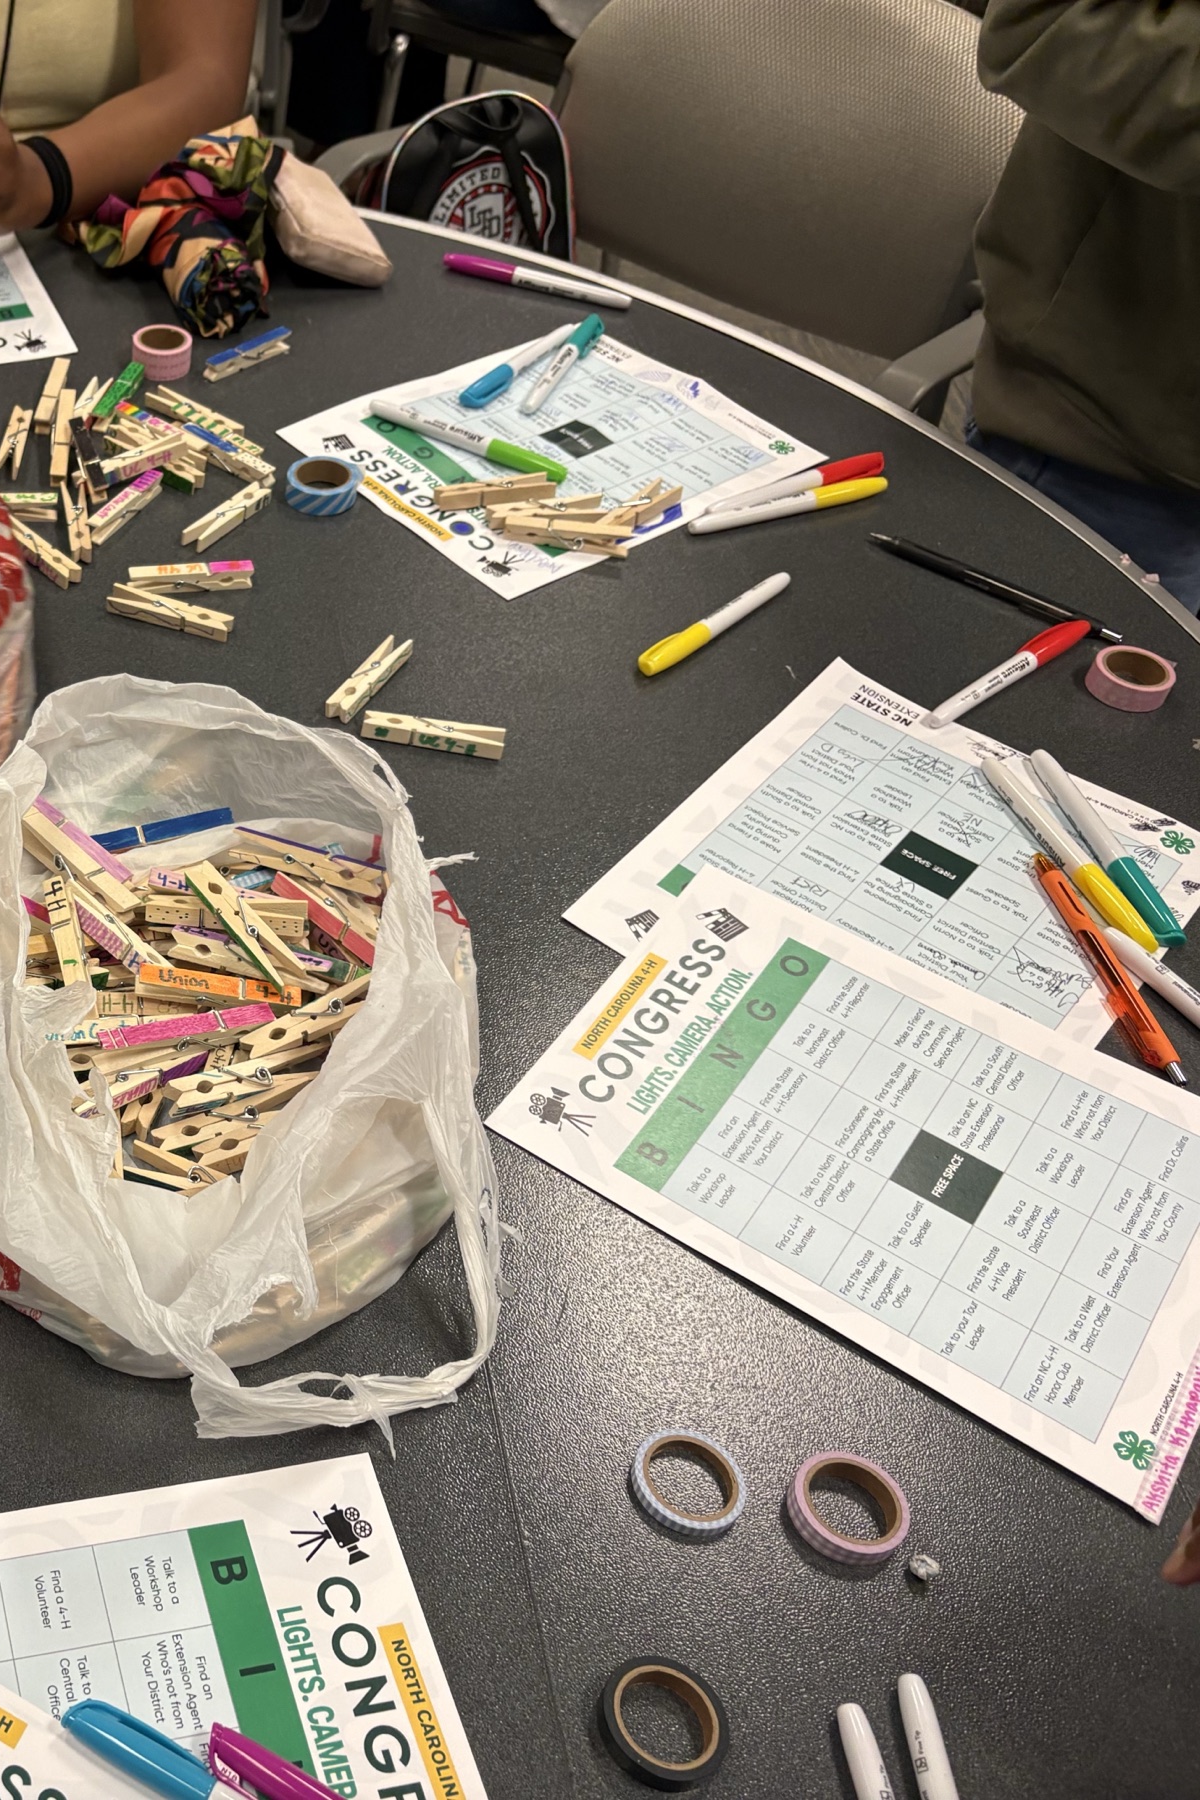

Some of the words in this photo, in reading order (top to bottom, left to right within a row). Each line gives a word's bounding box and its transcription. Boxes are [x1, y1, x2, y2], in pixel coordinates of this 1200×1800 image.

[415, 513, 443, 537] NORTH
[850, 692, 891, 716] STATE
[859, 684, 919, 719] EXTENSION
[891, 713, 912, 726] NC
[901, 848, 931, 867] SPACE
[932, 865, 956, 880] FREE
[158, 969, 210, 990] Union
[581, 1016, 612, 1049] NORTH
[606, 975, 646, 1017] CAROLINA
[641, 959, 658, 975] 4-H
[579, 939, 726, 1102] CONGRESS
[626, 1066, 678, 1115] LIGHTS.
[664, 1015, 719, 1067] CAMERA.
[706, 968, 753, 1016] ACTION.
[890, 1061, 907, 1079] State
[759, 1092, 775, 1107] Find
[769, 1082, 782, 1094] the
[776, 1066, 794, 1083] State
[773, 1099, 787, 1113] 4-H
[781, 1072, 808, 1101] Secretary
[874, 1087, 889, 1102] Find
[884, 1077, 897, 1089] the
[890, 1094, 903, 1108] 4-H
[897, 1068, 921, 1096] President
[1171, 1135, 1189, 1157] Collins
[1158, 1165, 1173, 1182] Find
[1166, 1157, 1178, 1168] Dr.
[686, 1180, 702, 1194] Talk
[697, 1173, 708, 1181] to
[931, 1177, 950, 1198] FREE
[942, 1153, 964, 1179] SPACE
[699, 1172, 727, 1204] Workshop
[715, 1184, 736, 1208] Leader
[775, 1233, 791, 1251] Find
[789, 1214, 804, 1230] 4-H
[887, 1234, 903, 1249] Talk
[898, 1226, 908, 1235] to
[906, 1200, 925, 1221] Guest
[909, 1218, 932, 1247] Speaker
[791, 1225, 817, 1256] Volunteer
[856, 1249, 875, 1269] State
[850, 1268, 863, 1281] the
[857, 1285, 871, 1301] 4-H
[865, 1258, 888, 1287] Member
[839, 1278, 855, 1296] Find
[871, 1266, 904, 1311] Engagement
[892, 1284, 912, 1309] Officer
[1045, 1344, 1059, 1362] 4-H
[1035, 1373, 1045, 1386] an
[1038, 1360, 1052, 1375] NC
[1023, 1383, 1040, 1402] Find
[1044, 1379, 1063, 1404] Honor
[1056, 1362, 1072, 1381] Club
[1062, 1375, 1085, 1408] Member
[1150, 1413, 1165, 1436] NORTH
[1160, 1383, 1179, 1414] CAROLINA
[1173, 1371, 1184, 1384] 4-H
[161, 1556, 174, 1579] Talk
[49, 1570, 64, 1594] Find
[129, 1566, 145, 1606] Leader
[144, 1555, 163, 1612] Workshop
[167, 1581, 176, 1594] to
[34, 1575, 51, 1629] Volunteer
[55, 1596, 63, 1605] a
[170, 1596, 179, 1605] a
[58, 1607, 71, 1630] 4-H
[156, 1640, 172, 1676] Who's
[276, 1606, 325, 1702] LIGHTS.
[195, 1656, 210, 1681] Find
[391, 1638, 426, 1704] NORTH
[141, 1651, 153, 1678] Your
[147, 1680, 165, 1723] District
[165, 1678, 177, 1698] not
[171, 1633, 192, 1690] Extension
[185, 1693, 203, 1730] Agent
[202, 1684, 213, 1701] an
[170, 1701, 184, 1729] from
